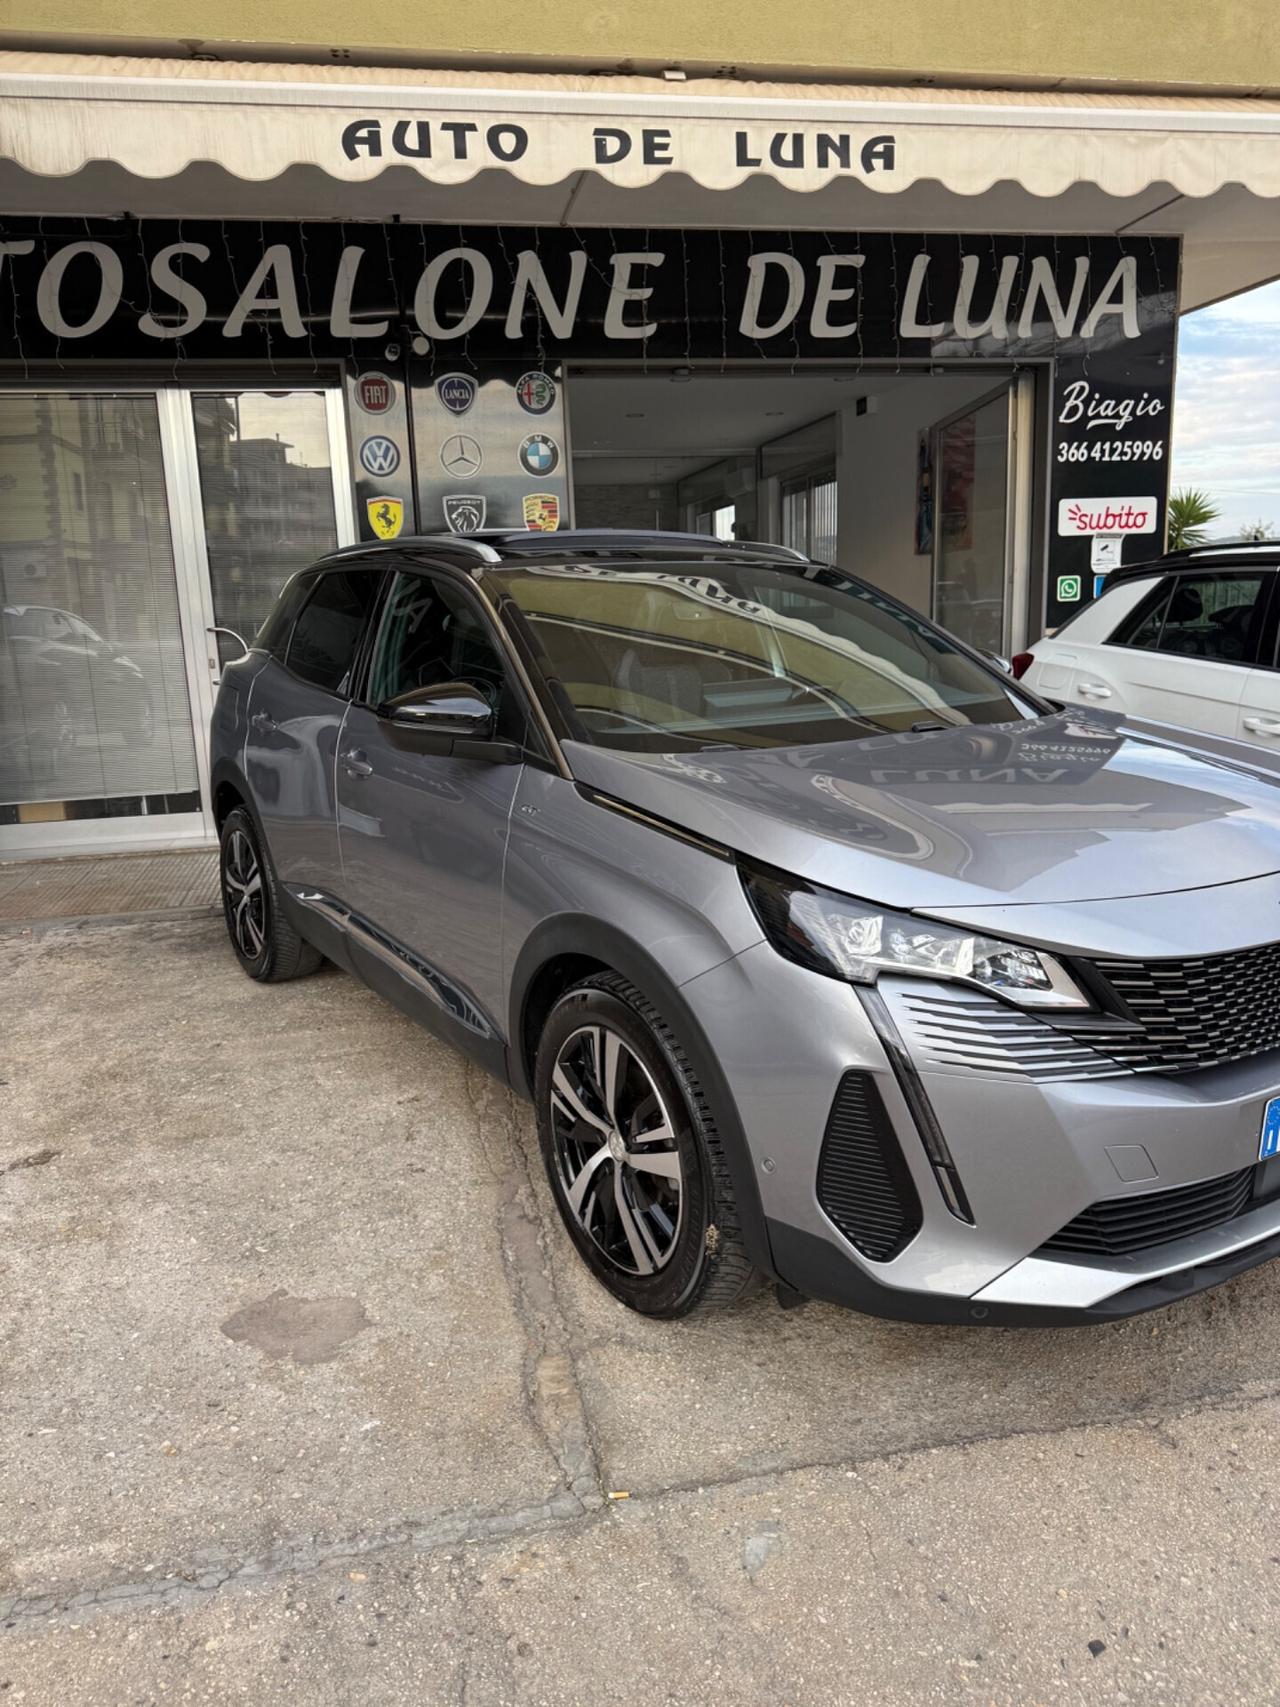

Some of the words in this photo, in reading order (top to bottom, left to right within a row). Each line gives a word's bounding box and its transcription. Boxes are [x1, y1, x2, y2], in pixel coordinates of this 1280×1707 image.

[341, 119, 528, 162] AUTO
[592, 127, 674, 165] DE
[735, 131, 896, 174] LUNA
[738, 252, 866, 339] DE
[899, 254, 1142, 340] LUNA
[364, 385, 387, 404] FIAT
[1058, 380, 1165, 431] Biagio
[1076, 504, 1148, 531] subito
